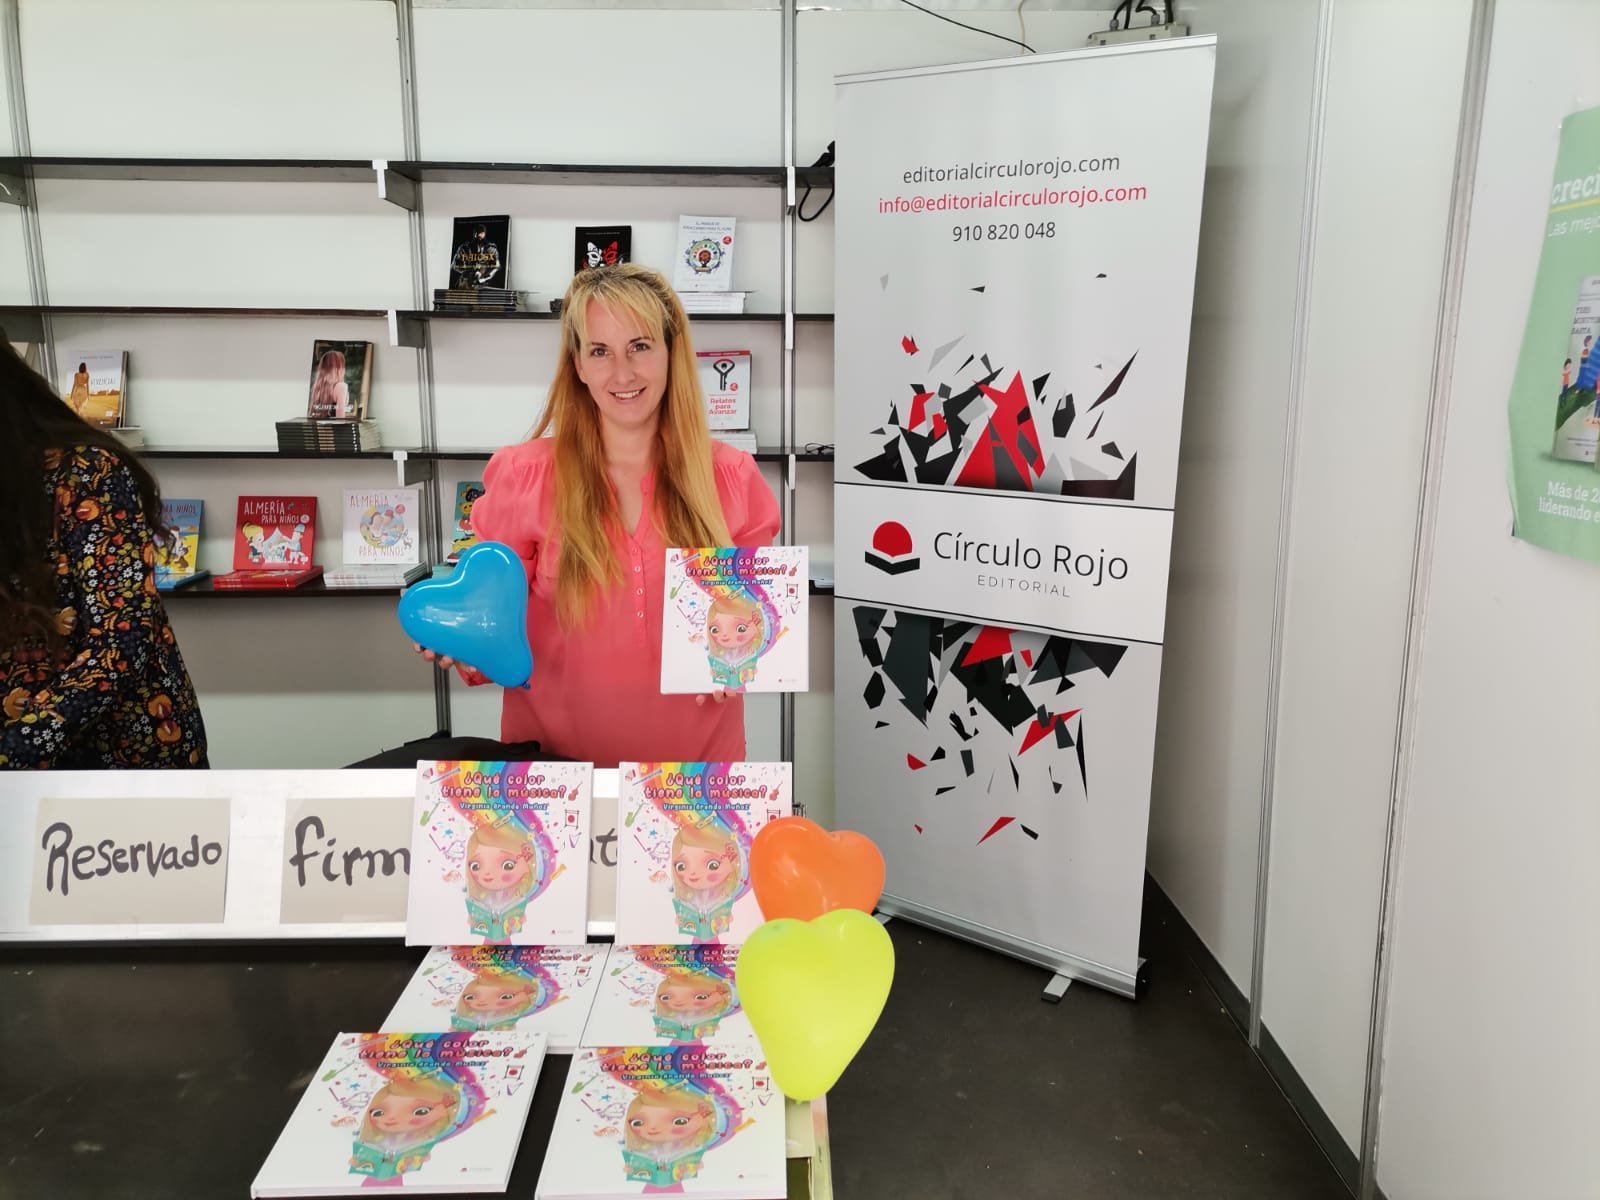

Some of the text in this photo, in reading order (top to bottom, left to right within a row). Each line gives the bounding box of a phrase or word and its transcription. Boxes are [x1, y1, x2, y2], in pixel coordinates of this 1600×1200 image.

[903, 155, 1120, 184] editorialcirculorojo.com
[878, 184, 1147, 213] info@editorialcirculorojo.com
[952, 221, 1056, 242] 910 820 048
[1547, 480, 1600, 504] Más de 2
[244, 501, 285, 515] ALMERÍA
[1538, 496, 1591, 520] liderando
[261, 514, 299, 524] PARA NIÑOS
[738, 556, 770, 566] color
[934, 532, 1129, 587] Círculo Rojo
[686, 567, 718, 577] tiene
[977, 575, 1071, 598] EDITORIAL
[464, 771, 545, 786] ¿Qué color
[666, 772, 746, 787] ¿Qué color
[441, 784, 567, 799] tiene la música?
[644, 784, 768, 800] tiene la música?
[460, 802, 490, 810] Virginia
[663, 803, 693, 811] Virginia
[288, 814, 411, 888] firm
[41, 821, 222, 897] Reservado
[443, 1038, 489, 1049] color
[359, 1049, 408, 1059] tiene
[682, 1052, 727, 1062] color
[601, 1062, 648, 1072] tiene
